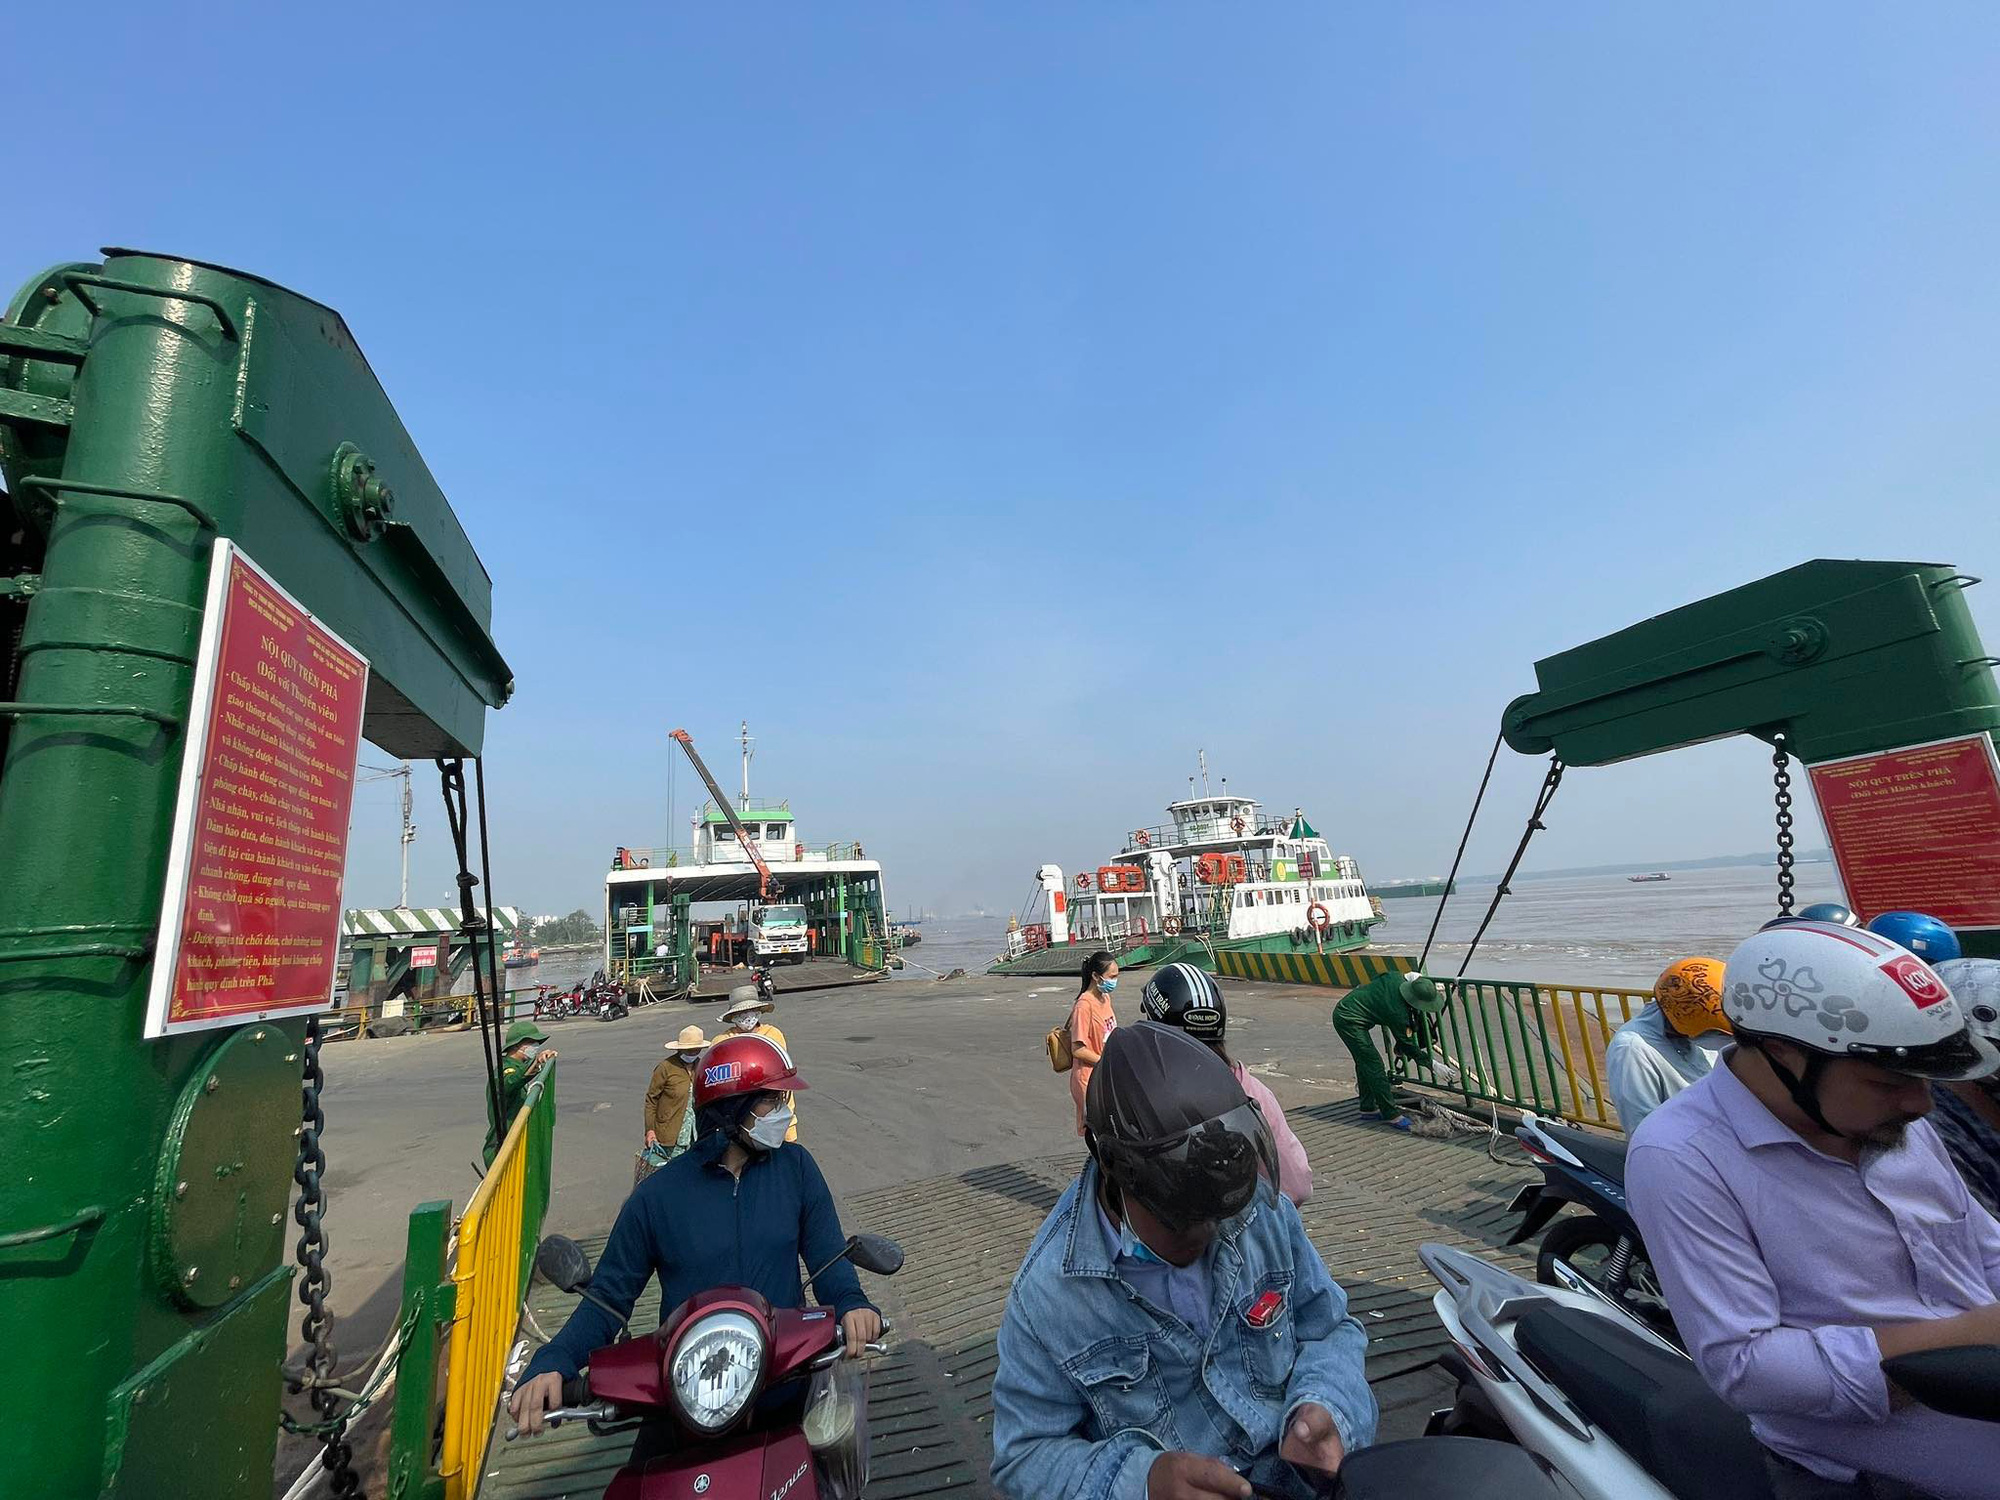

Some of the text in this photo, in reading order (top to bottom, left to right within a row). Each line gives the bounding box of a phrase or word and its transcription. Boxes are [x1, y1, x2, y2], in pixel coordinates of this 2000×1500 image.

[261, 636, 279, 658] NỘI
[281, 650, 298, 672] QUY
[299, 664, 319, 688] TRÊN
[321, 681, 337, 701] PHÀ
[231, 671, 251, 692] Chấp
[252, 683, 269, 701] hành
[227, 694, 244, 708] giao
[245, 701, 266, 721] thông
[278, 677, 290, 692] với
[318, 705, 337, 723] viên)
[225, 712, 245, 730] Nhắc
[222, 735, 231, 746] và
[232, 737, 255, 758] không
[219, 754, 238, 773] Chấp
[238, 762, 258, 779] hành
[1871, 775, 1892, 789] QUY
[251, 812, 264, 822] vui
[256, 852, 276, 865] hành
[254, 893, 265, 904] số
[245, 933, 263, 945] chối
[239, 976, 255, 987] trên
